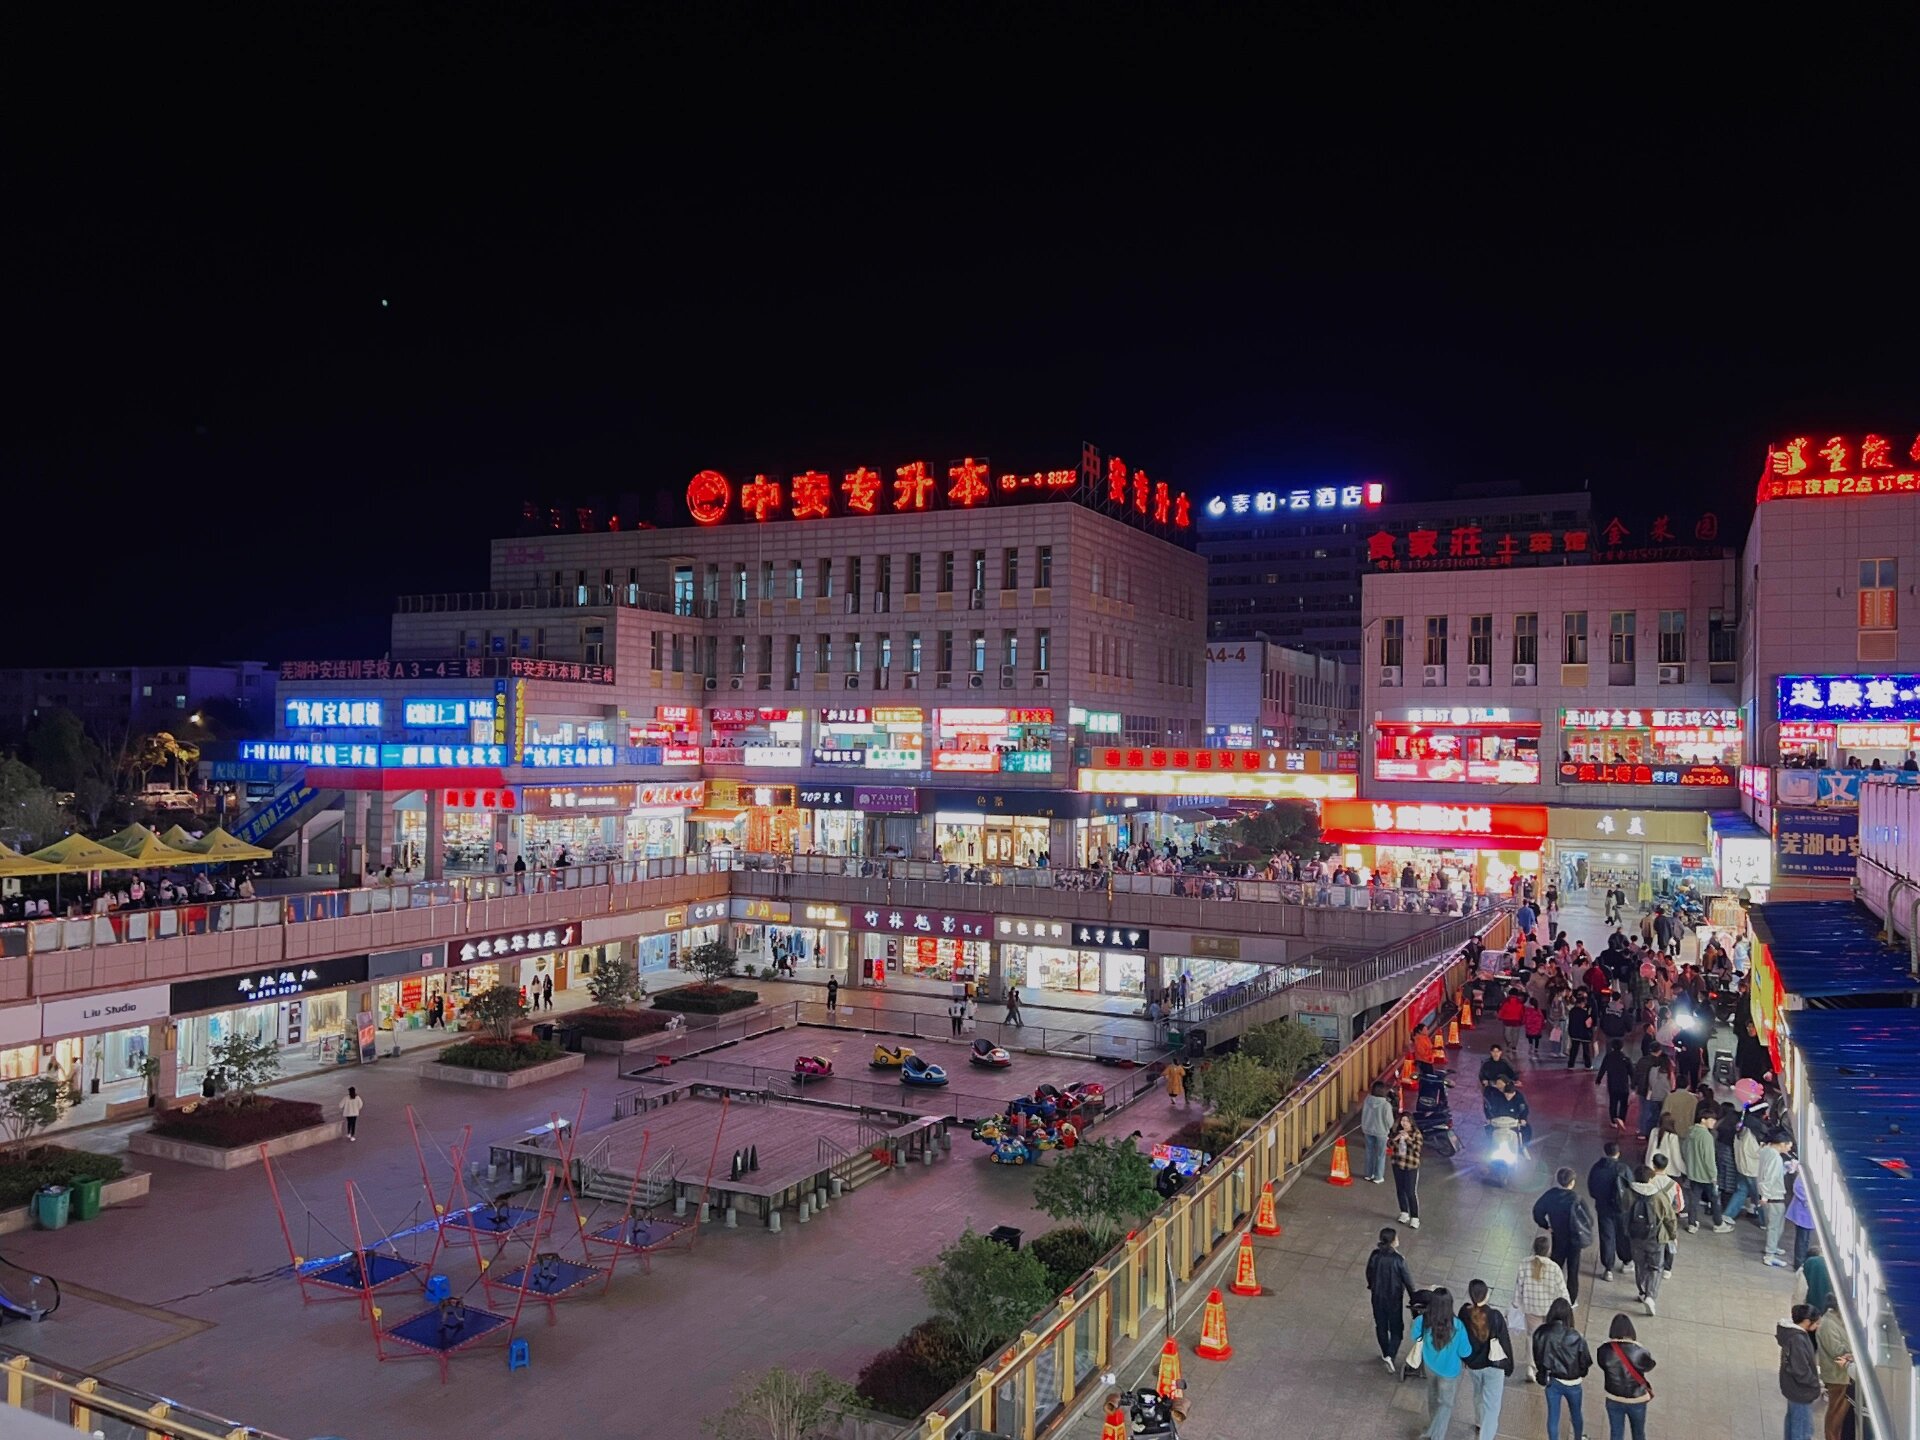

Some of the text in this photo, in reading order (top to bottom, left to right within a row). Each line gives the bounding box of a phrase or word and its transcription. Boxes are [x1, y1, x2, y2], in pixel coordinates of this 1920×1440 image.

[1206, 647, 1246, 663] A4-4
[1652, 710, 1738, 727] 重庆鸡公煲
[83, 1003, 137, 1019] Liu Studio
